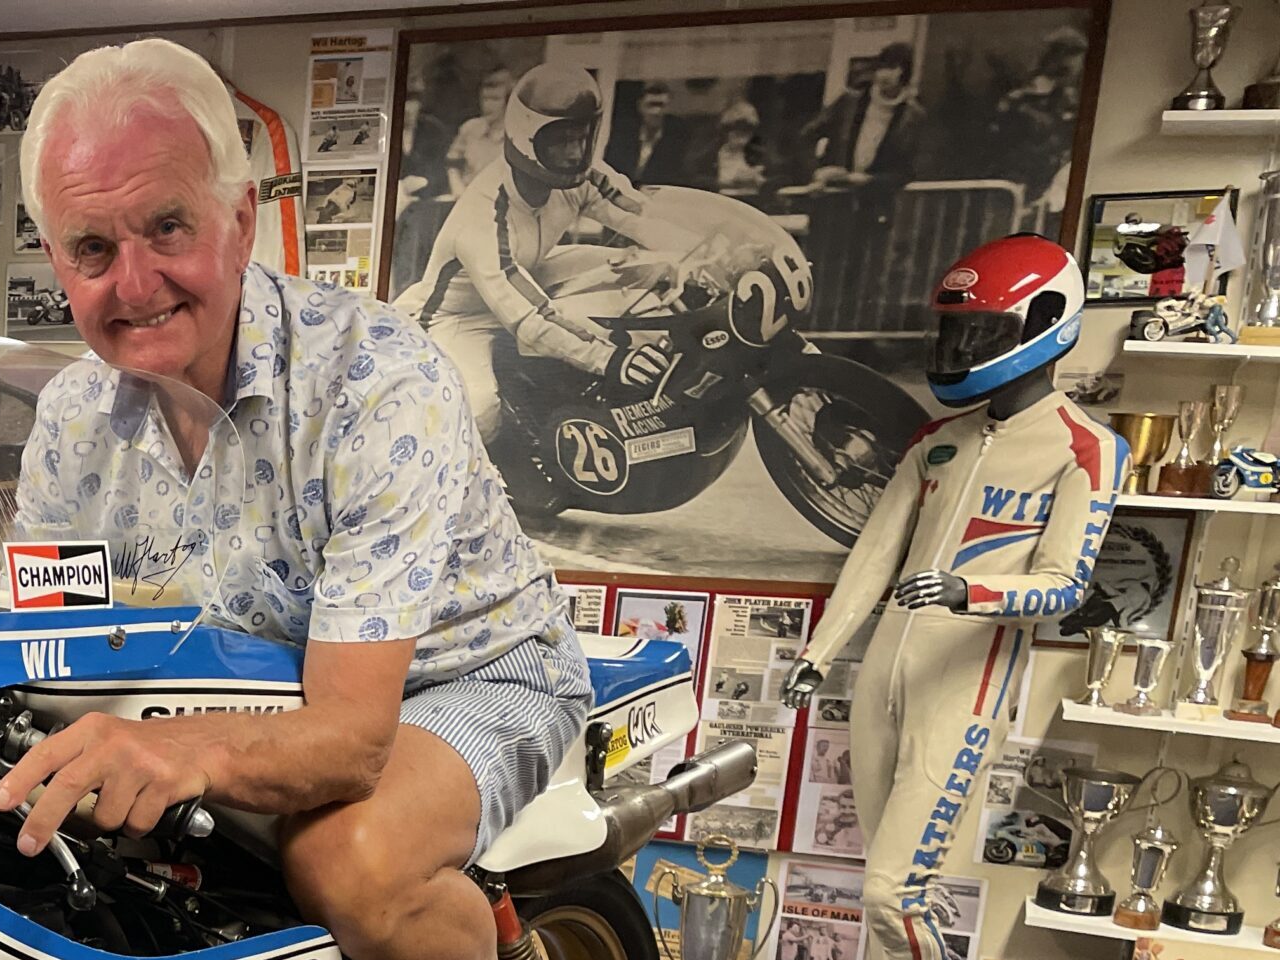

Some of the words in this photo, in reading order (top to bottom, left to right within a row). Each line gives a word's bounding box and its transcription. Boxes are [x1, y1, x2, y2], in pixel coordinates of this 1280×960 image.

[562, 424, 618, 482] 26
[19, 565, 103, 588] CHAMPION
[744, 598, 771, 607] PLAYER
[773, 600, 792, 608] RACE
[21, 640, 71, 679] WIL
[720, 730, 772, 739] INTERNATIONAL
[782, 905, 808, 915] ISLE
[811, 908, 828, 917] OF
